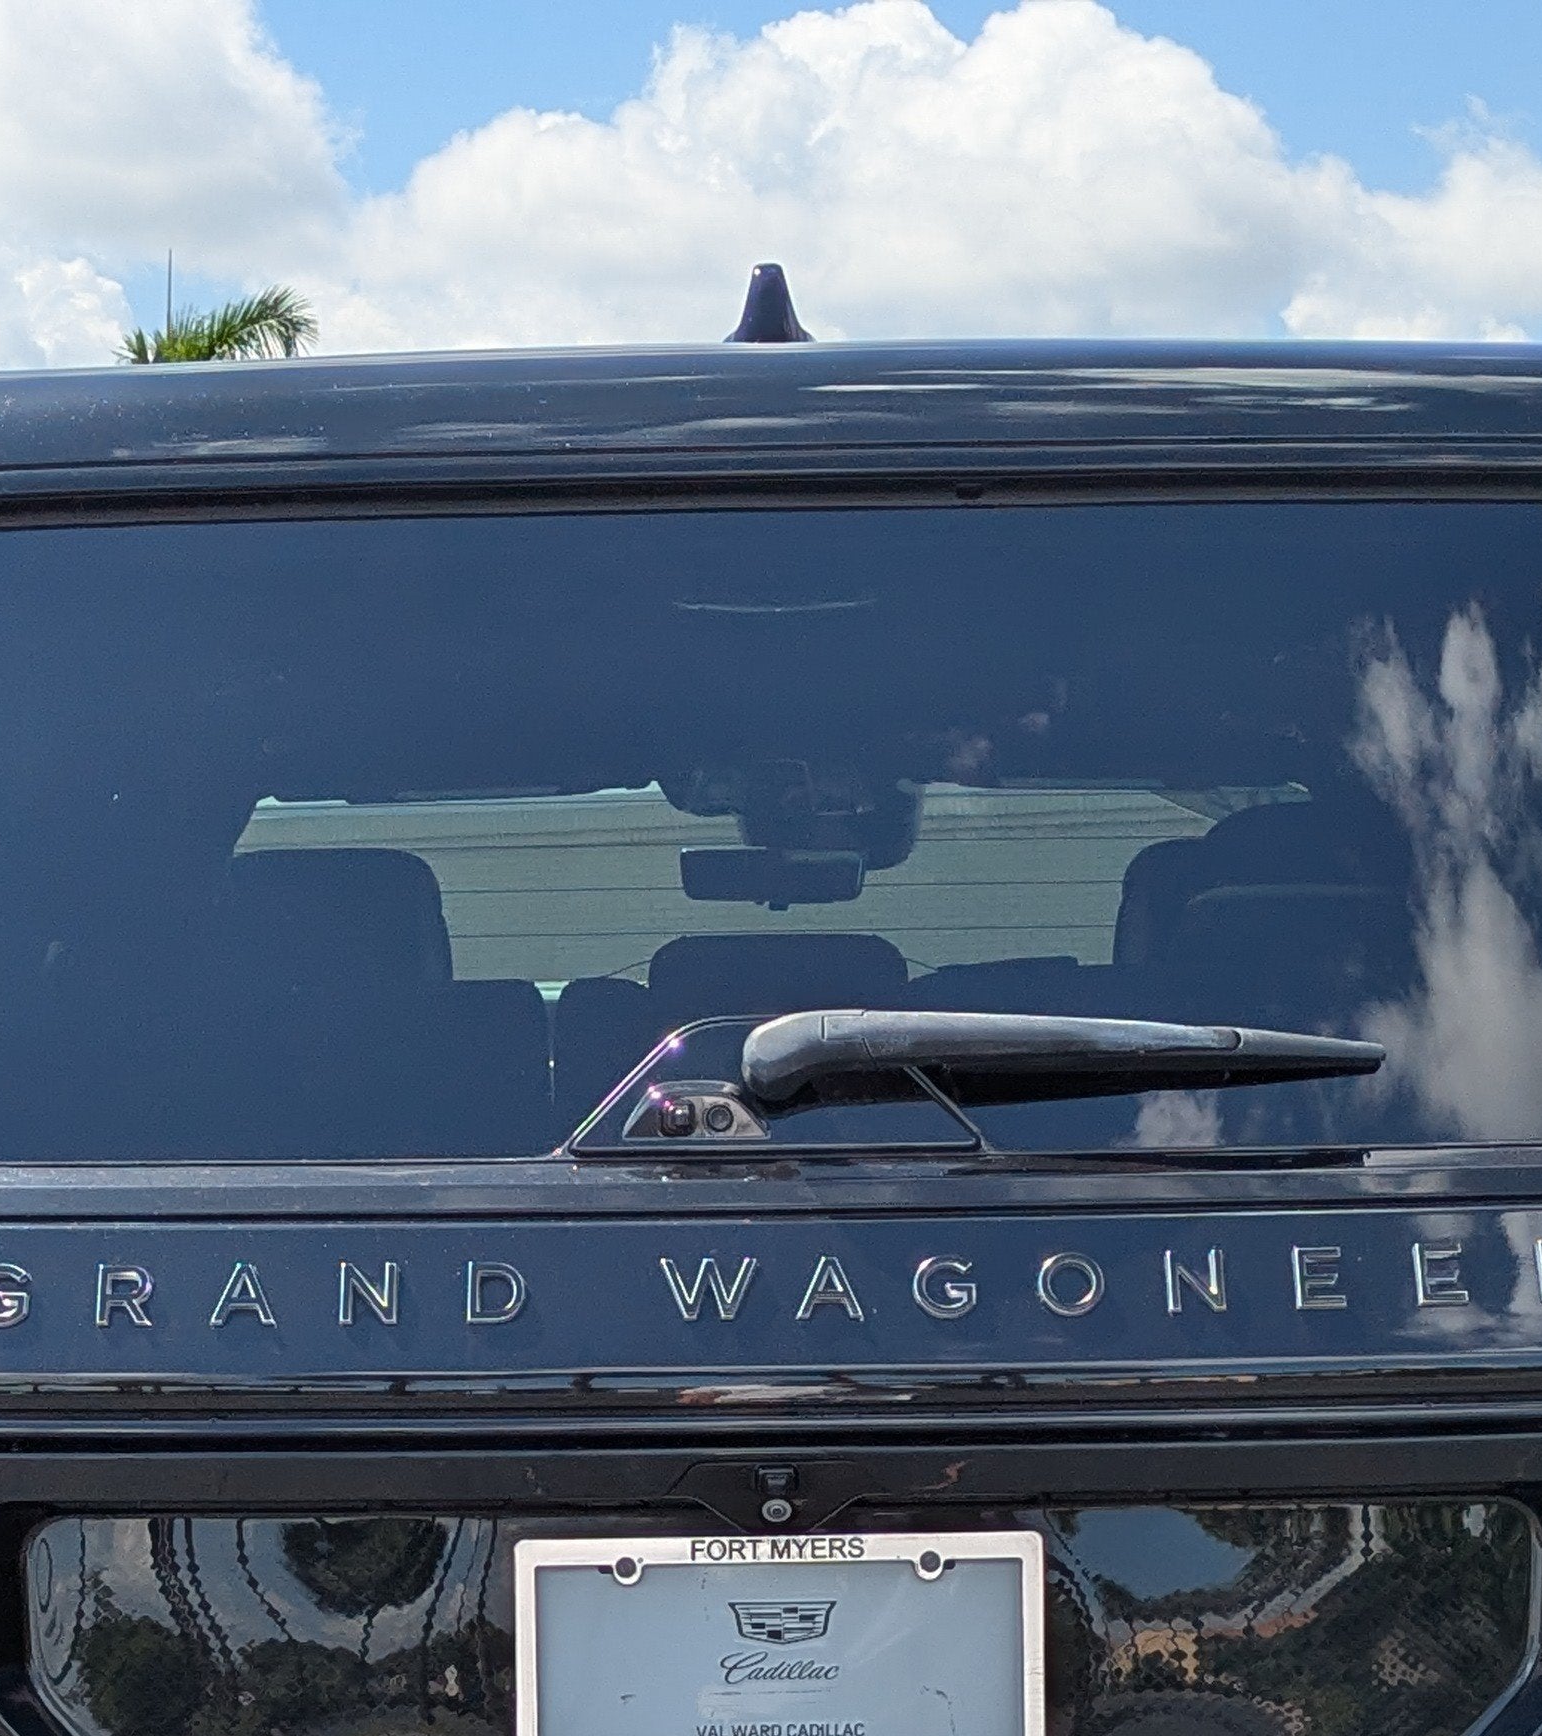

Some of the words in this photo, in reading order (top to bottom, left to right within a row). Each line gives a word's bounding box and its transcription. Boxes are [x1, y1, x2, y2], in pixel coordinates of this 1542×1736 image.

[690, 1539, 762, 1561] FORT
[770, 1537, 865, 1559] MYERS
[720, 1651, 840, 1684] Cadillac
